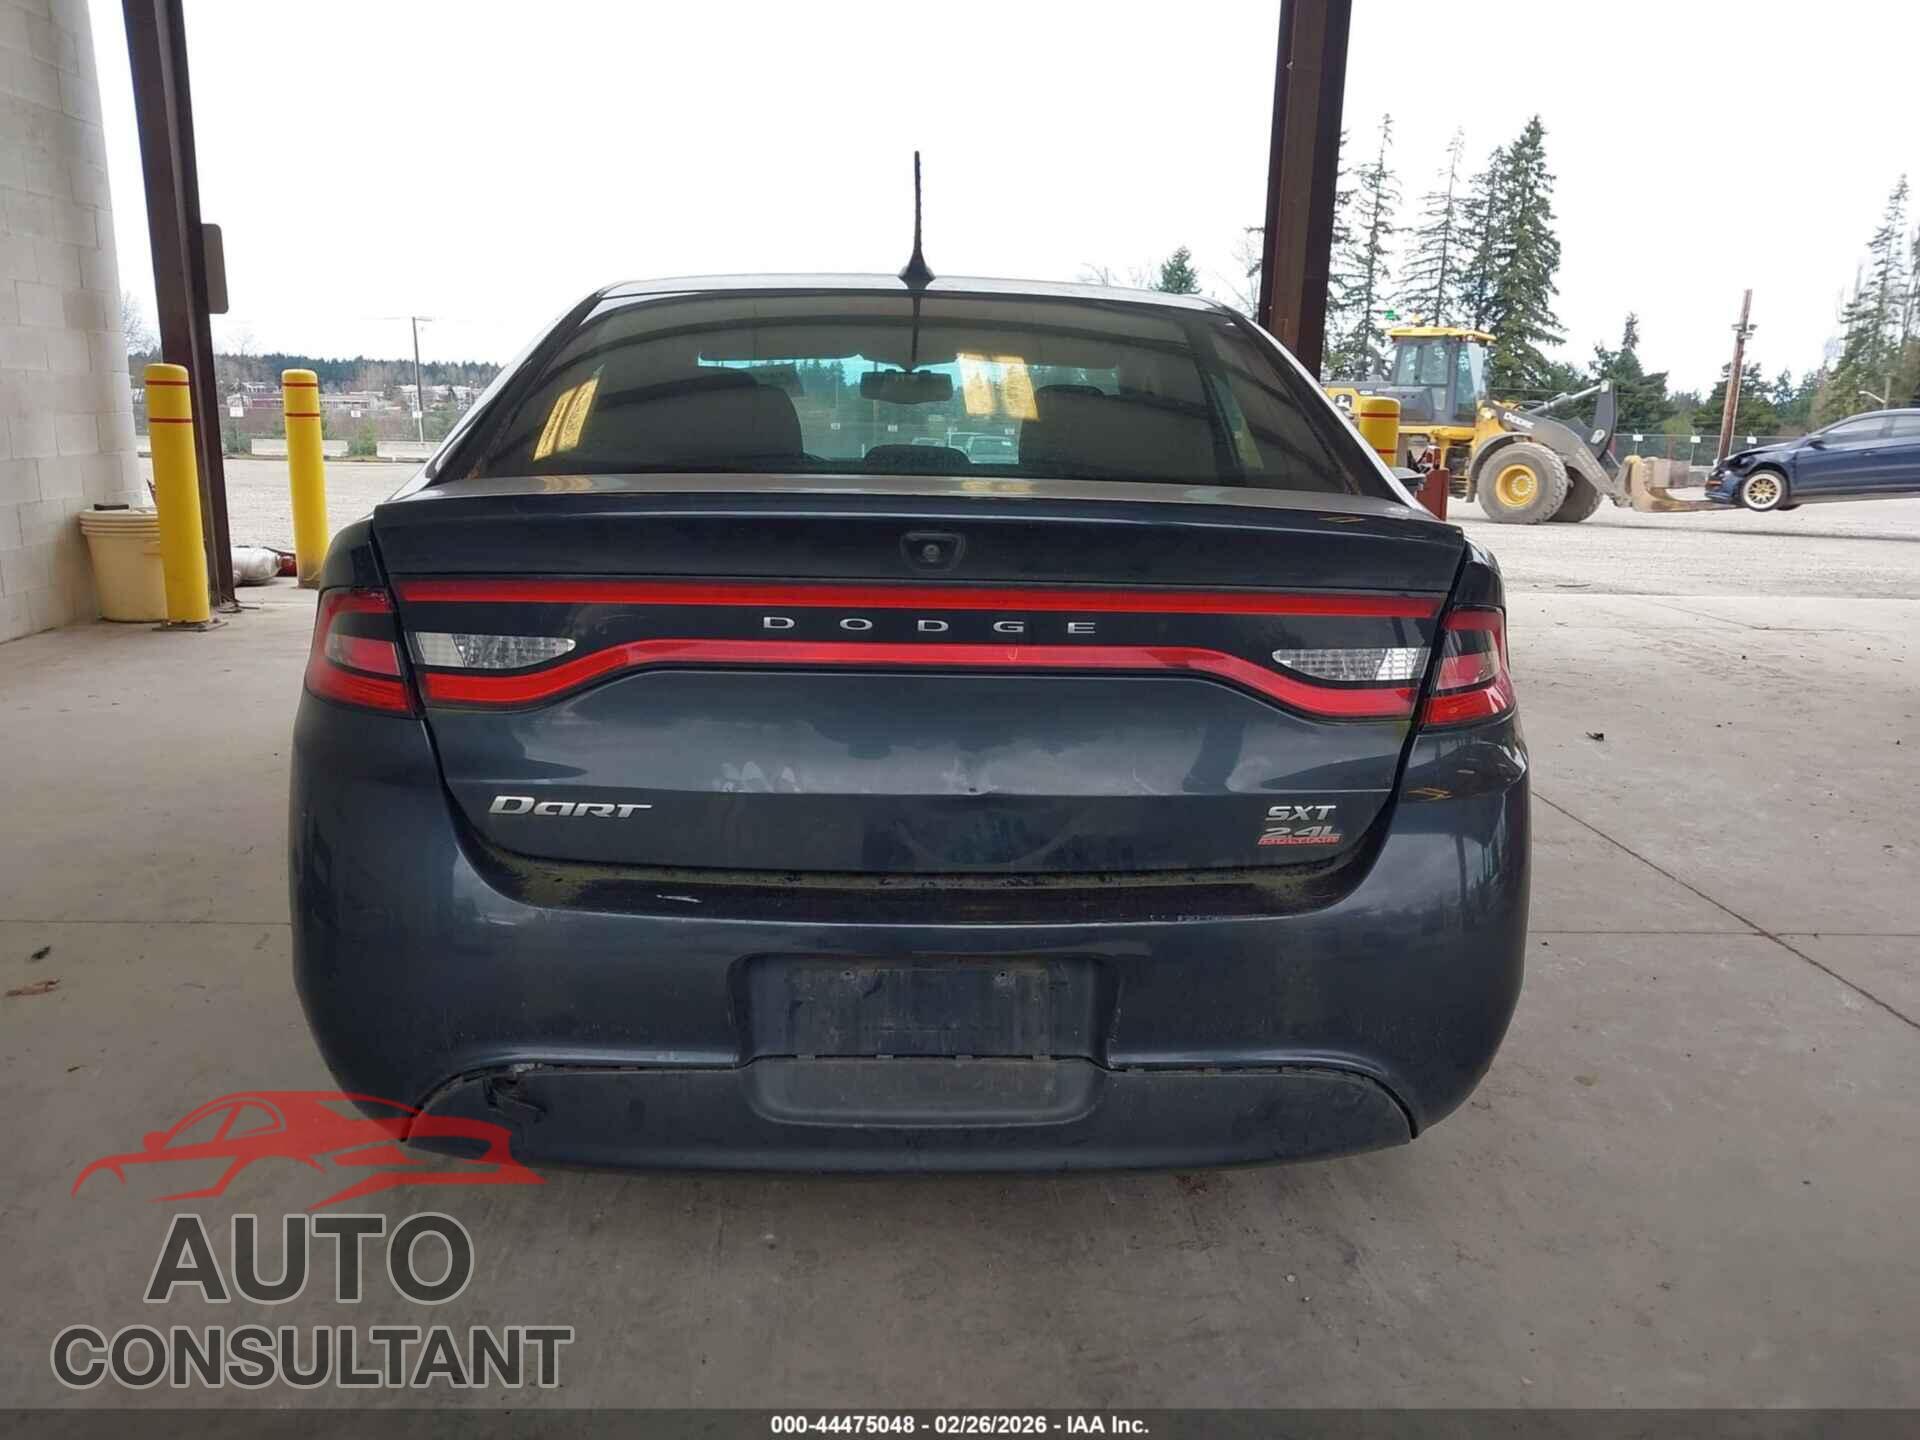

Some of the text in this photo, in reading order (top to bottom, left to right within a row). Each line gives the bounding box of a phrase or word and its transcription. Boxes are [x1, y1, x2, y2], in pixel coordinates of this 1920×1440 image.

[762, 615, 1097, 635] DODGE
[1265, 805, 1337, 821] SXT
[1262, 826, 1342, 838] 2.4L
